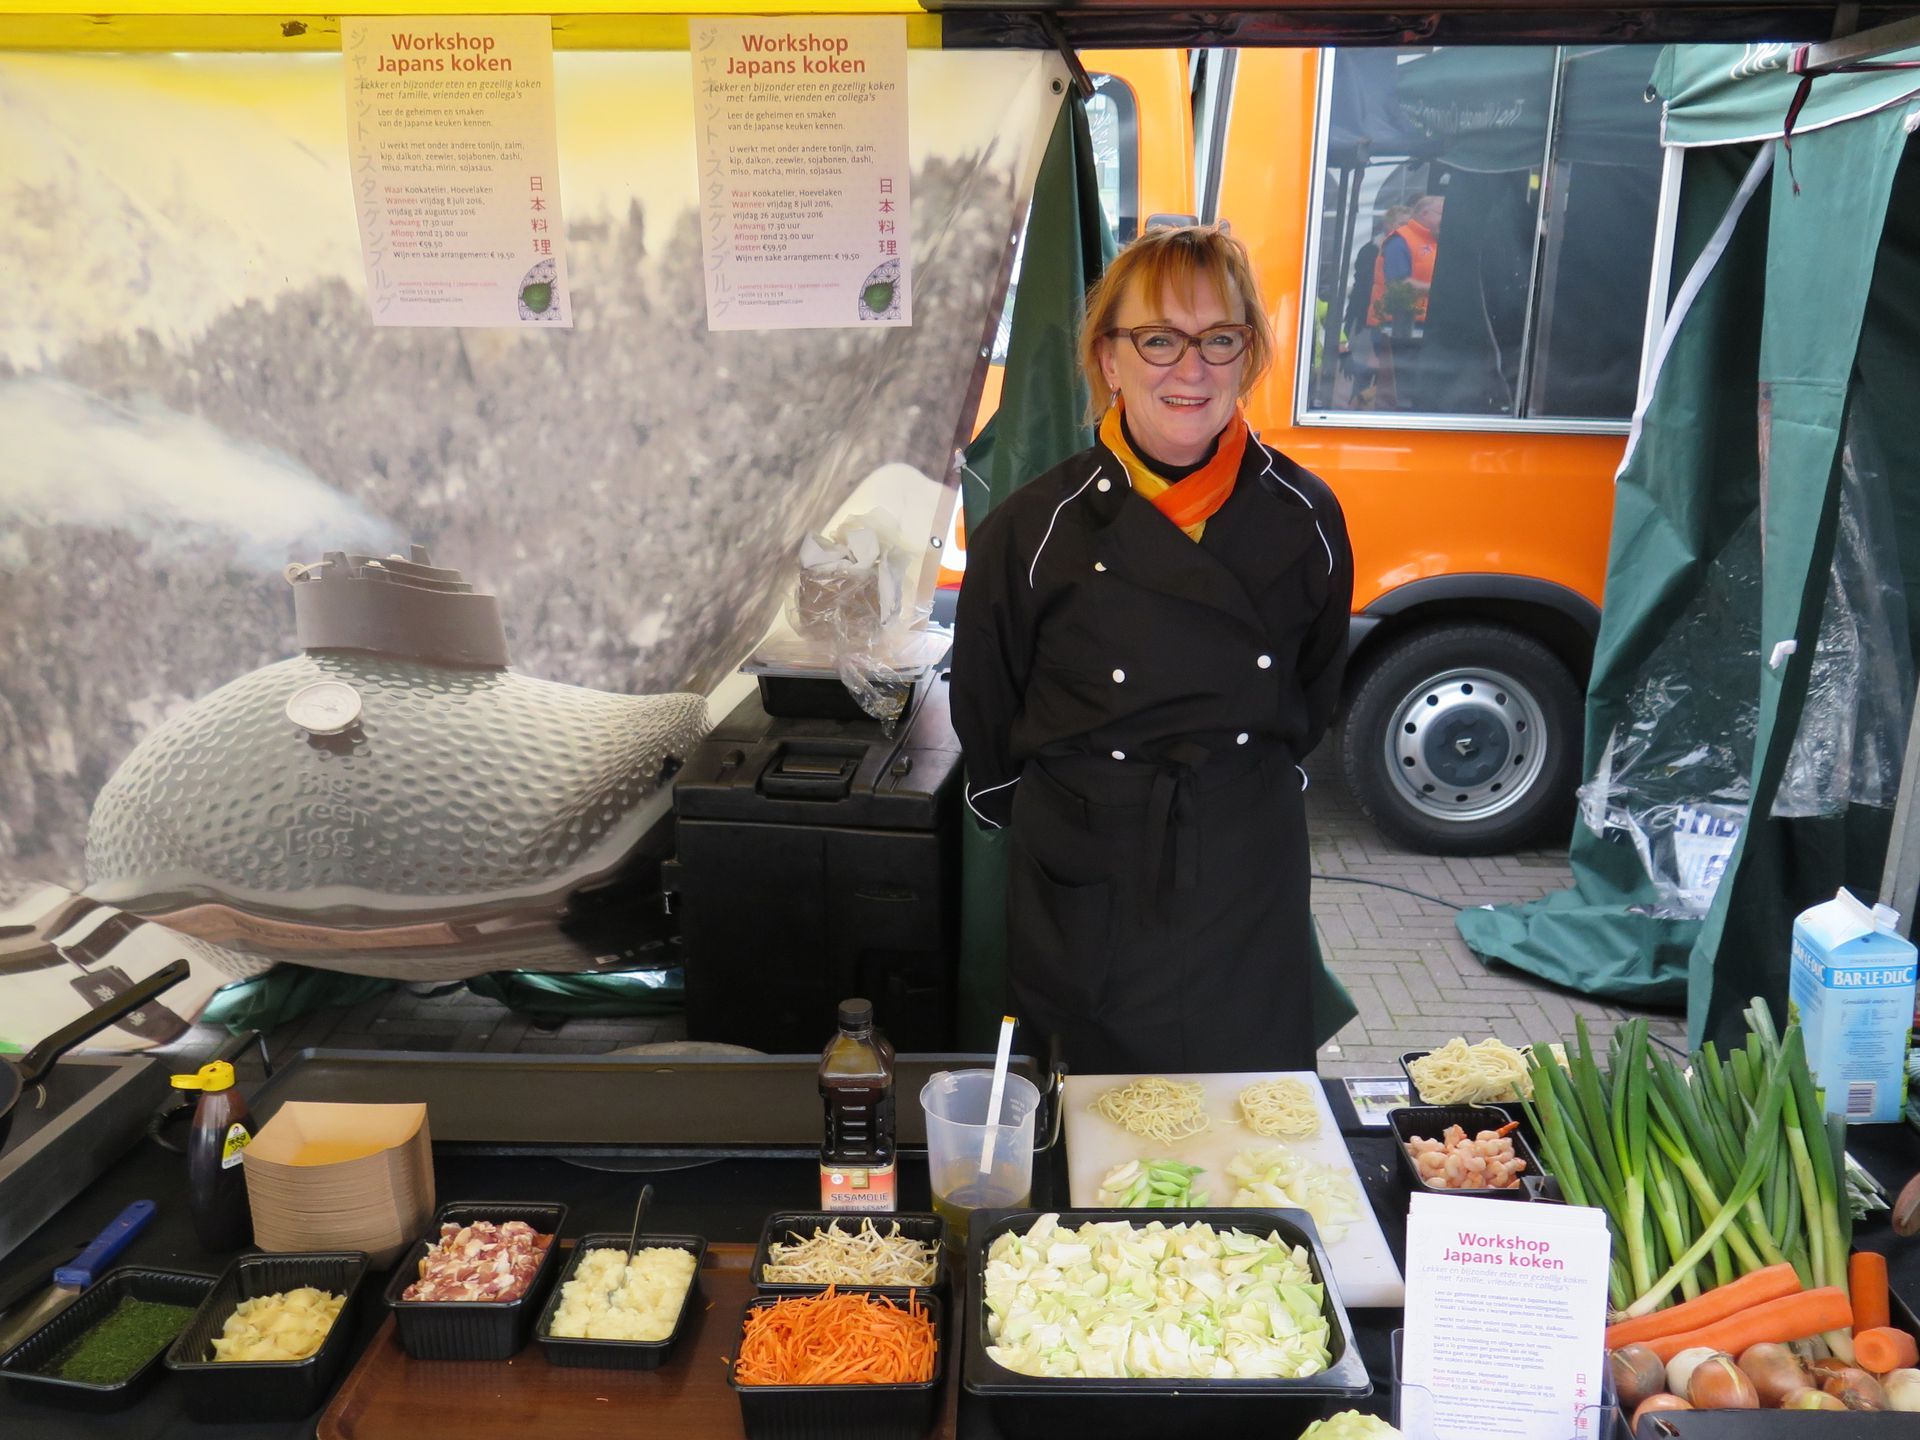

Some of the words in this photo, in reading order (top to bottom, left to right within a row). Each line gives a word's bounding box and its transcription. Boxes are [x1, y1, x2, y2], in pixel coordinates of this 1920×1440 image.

[392, 33, 494, 53] Workshop
[742, 34, 848, 56] Workshop
[377, 56, 444, 76] Japans
[451, 54, 512, 71] koken
[727, 57, 796, 78] Japans
[803, 56, 865, 73] koken
[360, 81, 388, 89] Lekker
[404, 80, 443, 90] bijzonder
[446, 81, 464, 89] eten
[480, 80, 513, 91] gezellig
[515, 79, 541, 88] koken
[710, 83, 738, 92] Lekker
[754, 83, 795, 93] bijzonder
[832, 82, 865, 93] gezellig
[868, 82, 895, 90] koken
[377, 91, 394, 99] met
[398, 91, 430, 100] familie,
[433, 91, 470, 99] vrienden
[485, 90, 522, 101] collega's
[726, 94, 744, 102] met
[784, 93, 822, 102] vrienden
[838, 93, 876, 103] collega's
[406, 108, 442, 118] geheimen
[455, 108, 484, 116] smaken
[727, 112, 743, 120] Leer
[745, 111, 754, 119] de
[756, 111, 793, 122] geheimen
[807, 111, 836, 119] smaken
[435, 119, 462, 127] keuken
[463, 119, 493, 127] kennen.
[815, 122, 845, 130] kennen.
[478, 142, 502, 151] tonijn,
[504, 142, 525, 150] zalm,
[737, 145, 758, 153] werkt
[828, 145, 854, 154] tonijn,
[856, 144, 876, 153] zalm,
[381, 153, 394, 162] kip,
[396, 153, 422, 161] daikon,
[458, 153, 498, 161] sojabonen,
[500, 153, 522, 161] dashi,
[730, 157, 744, 166] kip,
[746, 156, 772, 165] daikon,
[808, 156, 849, 166] sojabonen,
[851, 156, 874, 164] dashi,
[382, 164, 401, 172] miso,
[404, 164, 434, 172] matcha,
[731, 168, 750, 177] miso,
[753, 168, 783, 176] matcha,
[785, 168, 808, 176] mirin,
[420, 198, 445, 207] vrijdag
[452, 198, 464, 206] juli
[767, 201, 792, 210] vrijdag
[800, 200, 813, 210] juli
[388, 209, 413, 218] vrijdag
[425, 209, 458, 218] augustus
[530, 177, 552, 255] 日本料理
[733, 212, 758, 221] vrijdag
[771, 212, 805, 220] augustus
[808, 211, 823, 219] 2016
[879, 179, 897, 256] 日本料理
[734, 223, 766, 232] Aanvang
[735, 233, 758, 242] Afloop
[780, 233, 799, 241] 23.00
[394, 251, 410, 260] Wijn
[736, 254, 752, 263] Wijn
[784, 254, 834, 262] arrangement:
[831, 1193, 888, 1202] SESAMOLIE
[1458, 1232, 1550, 1255] Workshop
[1444, 1248, 1503, 1266] Japans
[1509, 1253, 1564, 1270] koken
[1488, 1279, 1520, 1287] vrienden
